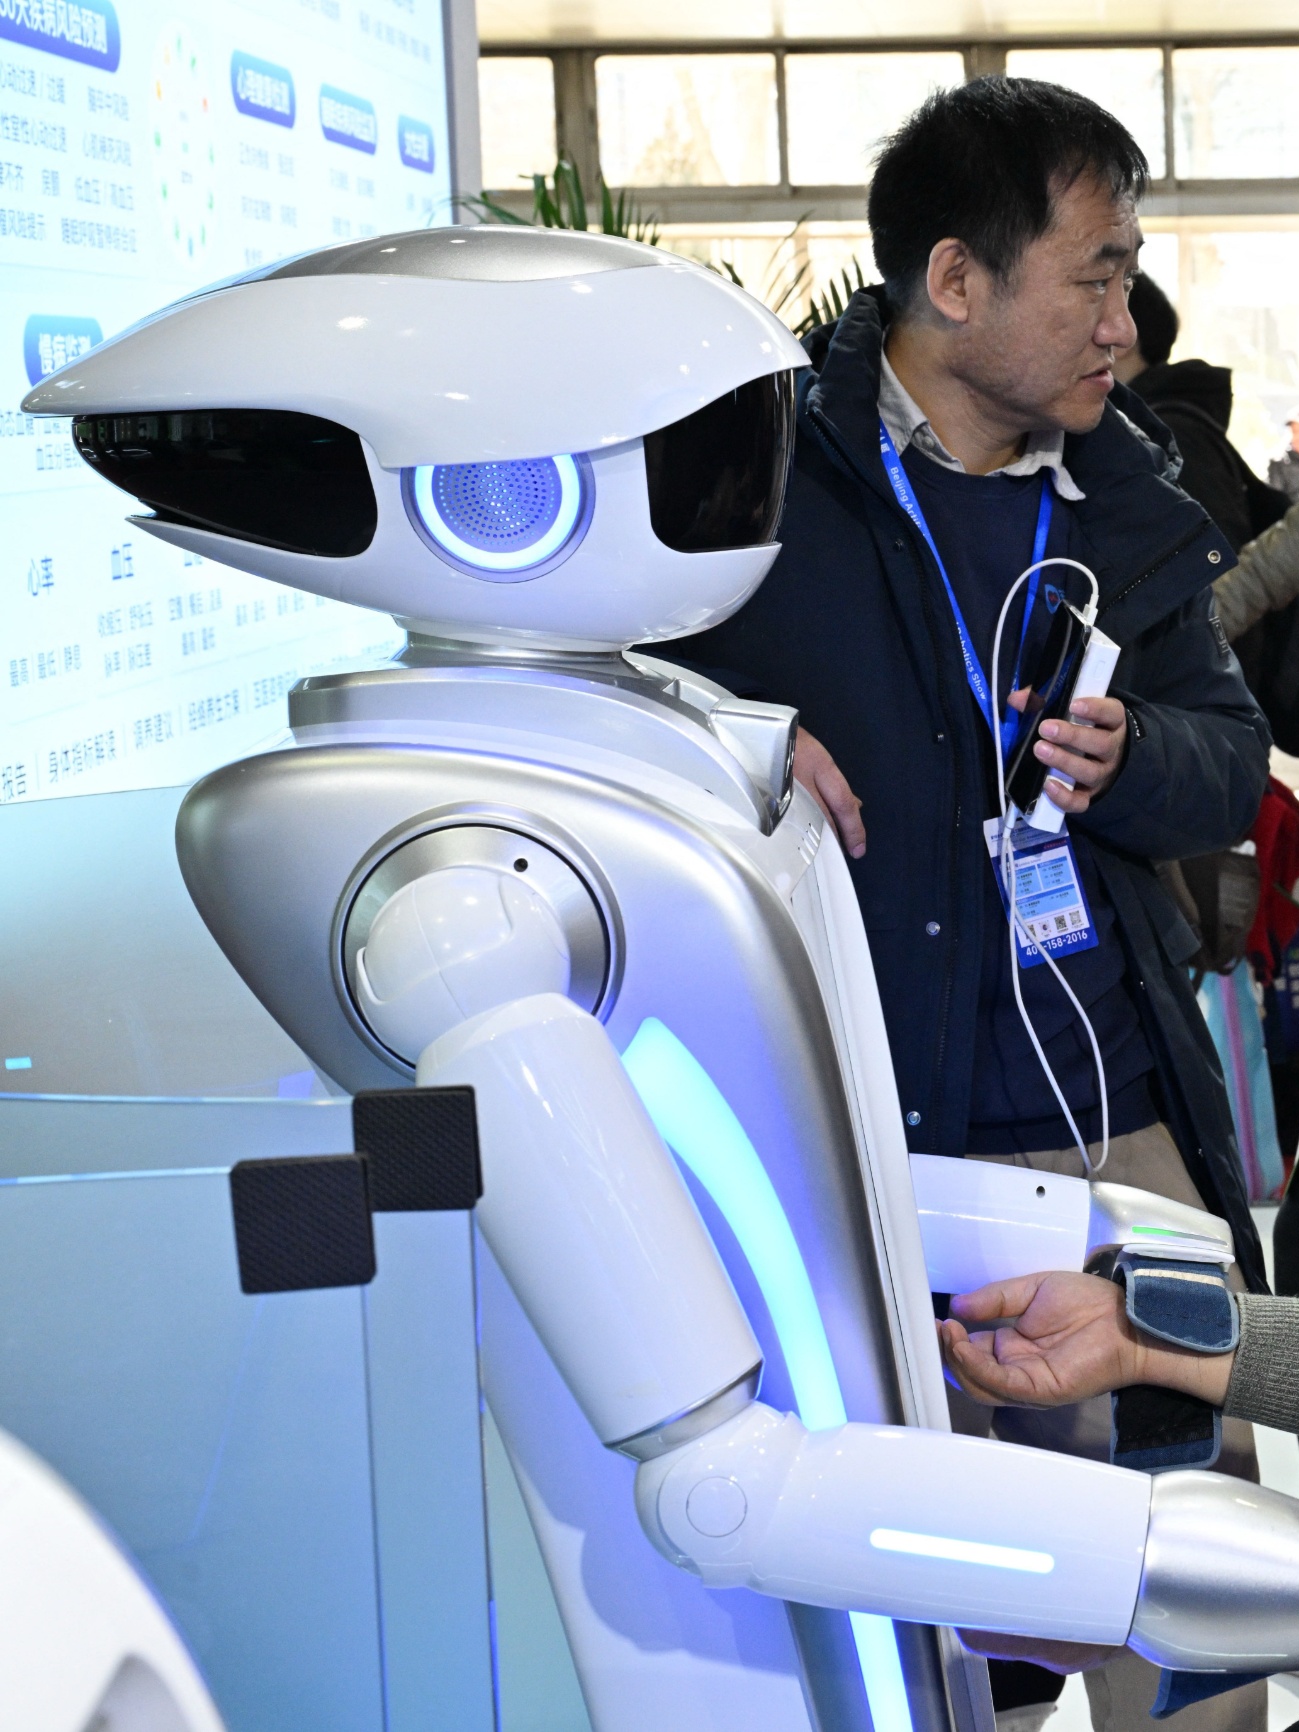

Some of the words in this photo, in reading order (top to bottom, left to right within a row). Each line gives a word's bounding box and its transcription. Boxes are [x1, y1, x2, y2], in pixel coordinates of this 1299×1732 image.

[27, 556, 55, 596] 心率
[111, 543, 135, 580] 血压
[890, 466, 909, 502] Beijing
[971, 673, 987, 701] Show
[1026, 931, 1088, 957] 40-158-2016
